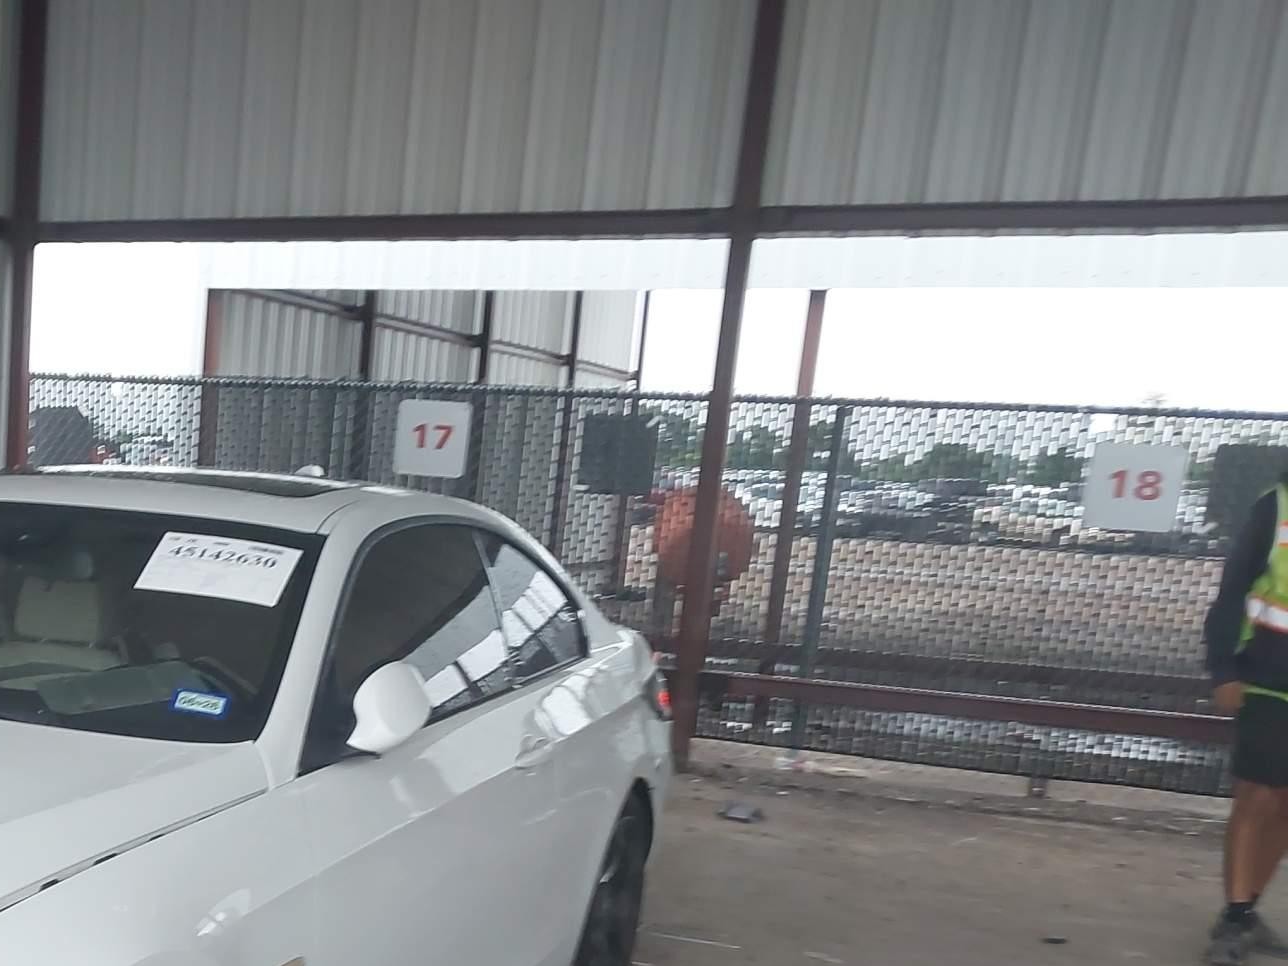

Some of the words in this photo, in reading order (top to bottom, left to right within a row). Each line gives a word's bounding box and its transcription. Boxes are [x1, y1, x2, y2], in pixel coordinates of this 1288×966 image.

[413, 423, 454, 449] 17
[1110, 470, 1163, 501] 18
[169, 544, 278, 569] 45142630
